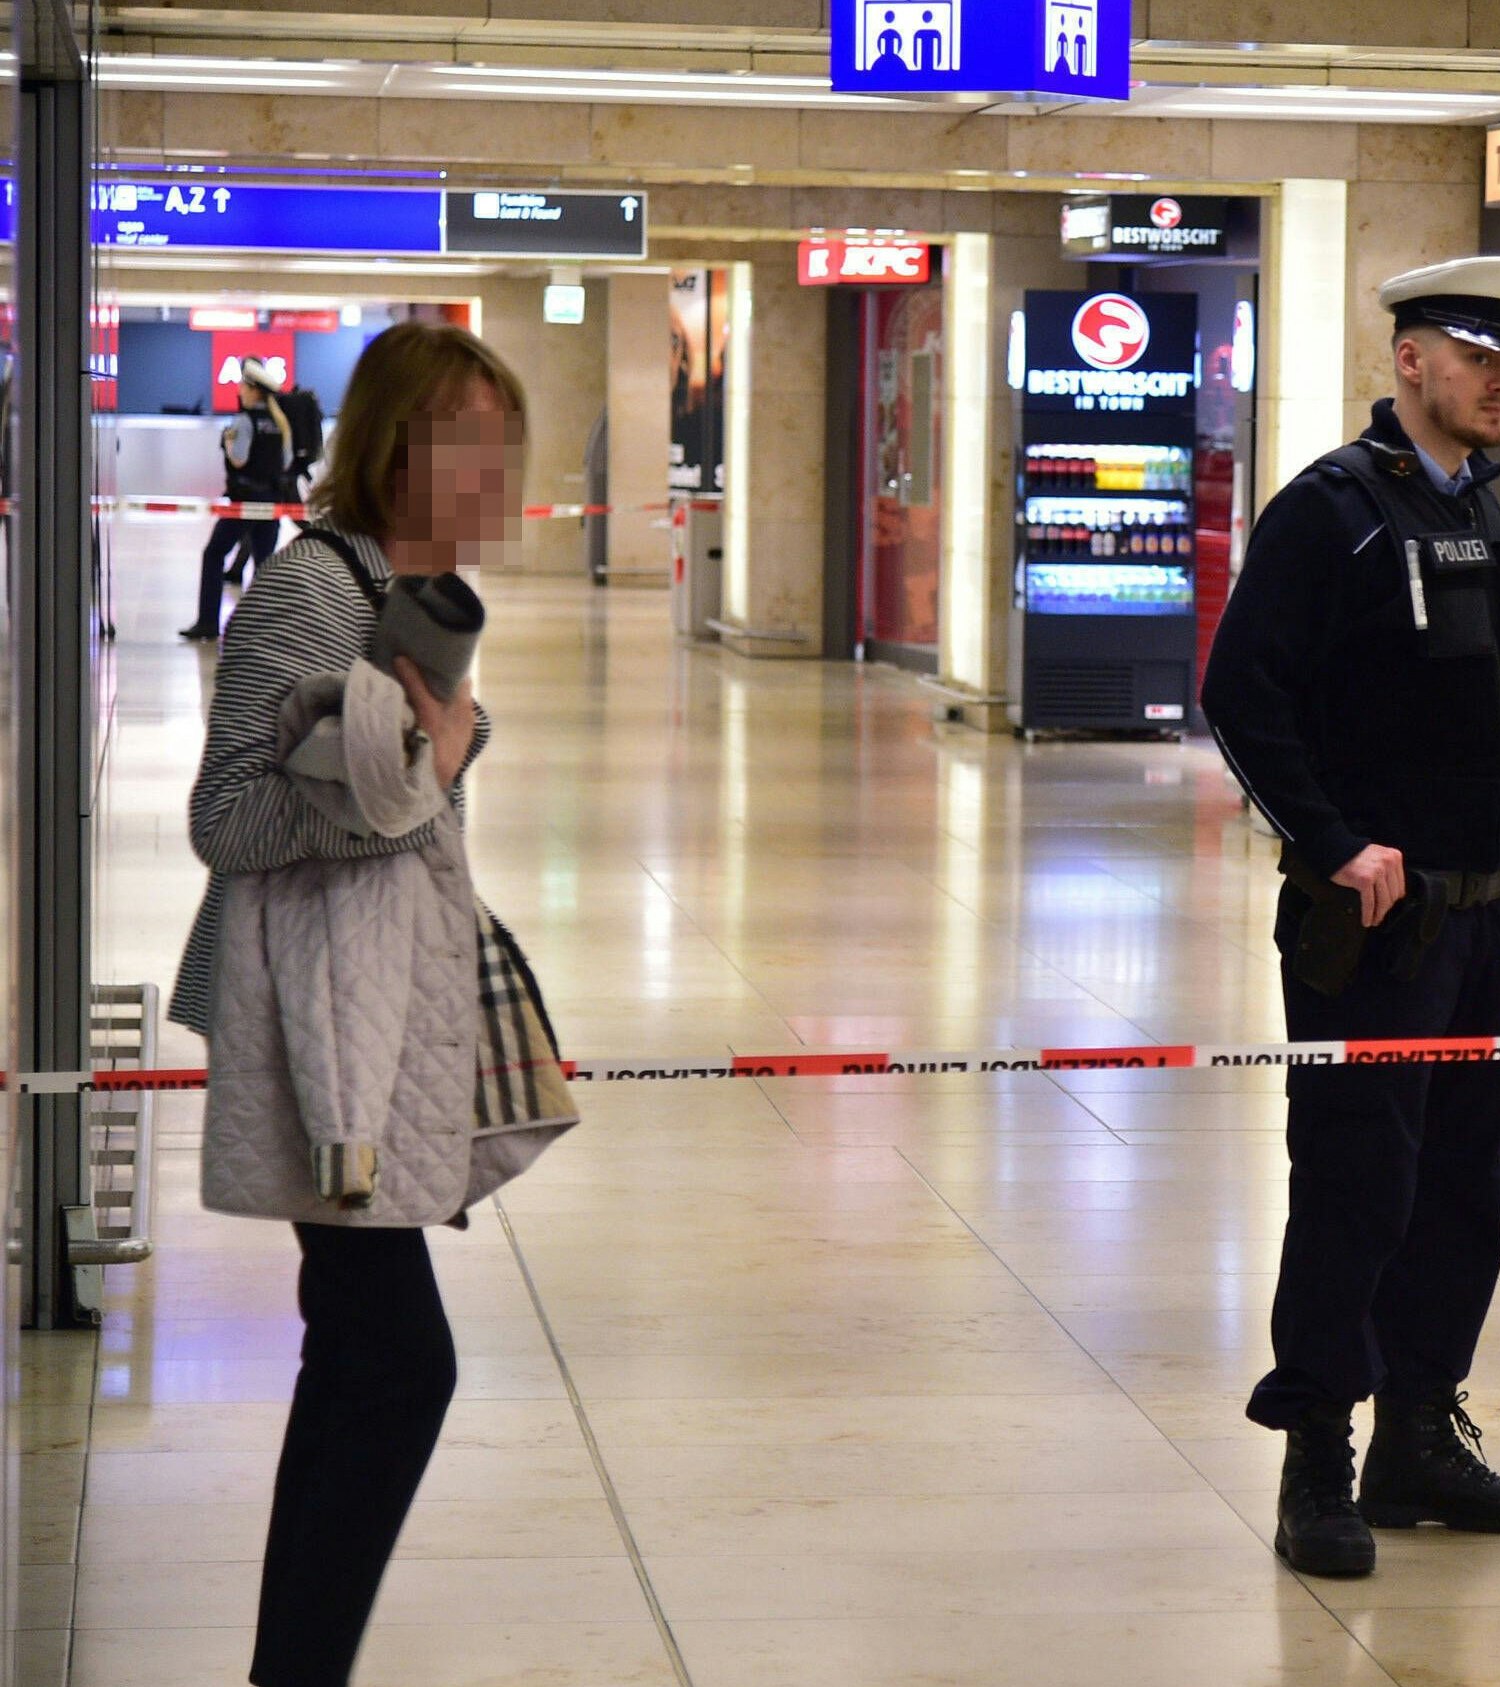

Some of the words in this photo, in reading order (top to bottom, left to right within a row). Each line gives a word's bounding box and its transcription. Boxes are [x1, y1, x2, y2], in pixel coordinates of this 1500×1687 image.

[1112, 227, 1219, 245] BESTWORSCHT
[840, 246, 925, 276] KFC
[1027, 369, 1191, 397] BESTWORSCHT
[1074, 396, 1095, 410] IN
[1099, 396, 1145, 411] TOWN
[1433, 539, 1489, 563] POLIZEI
